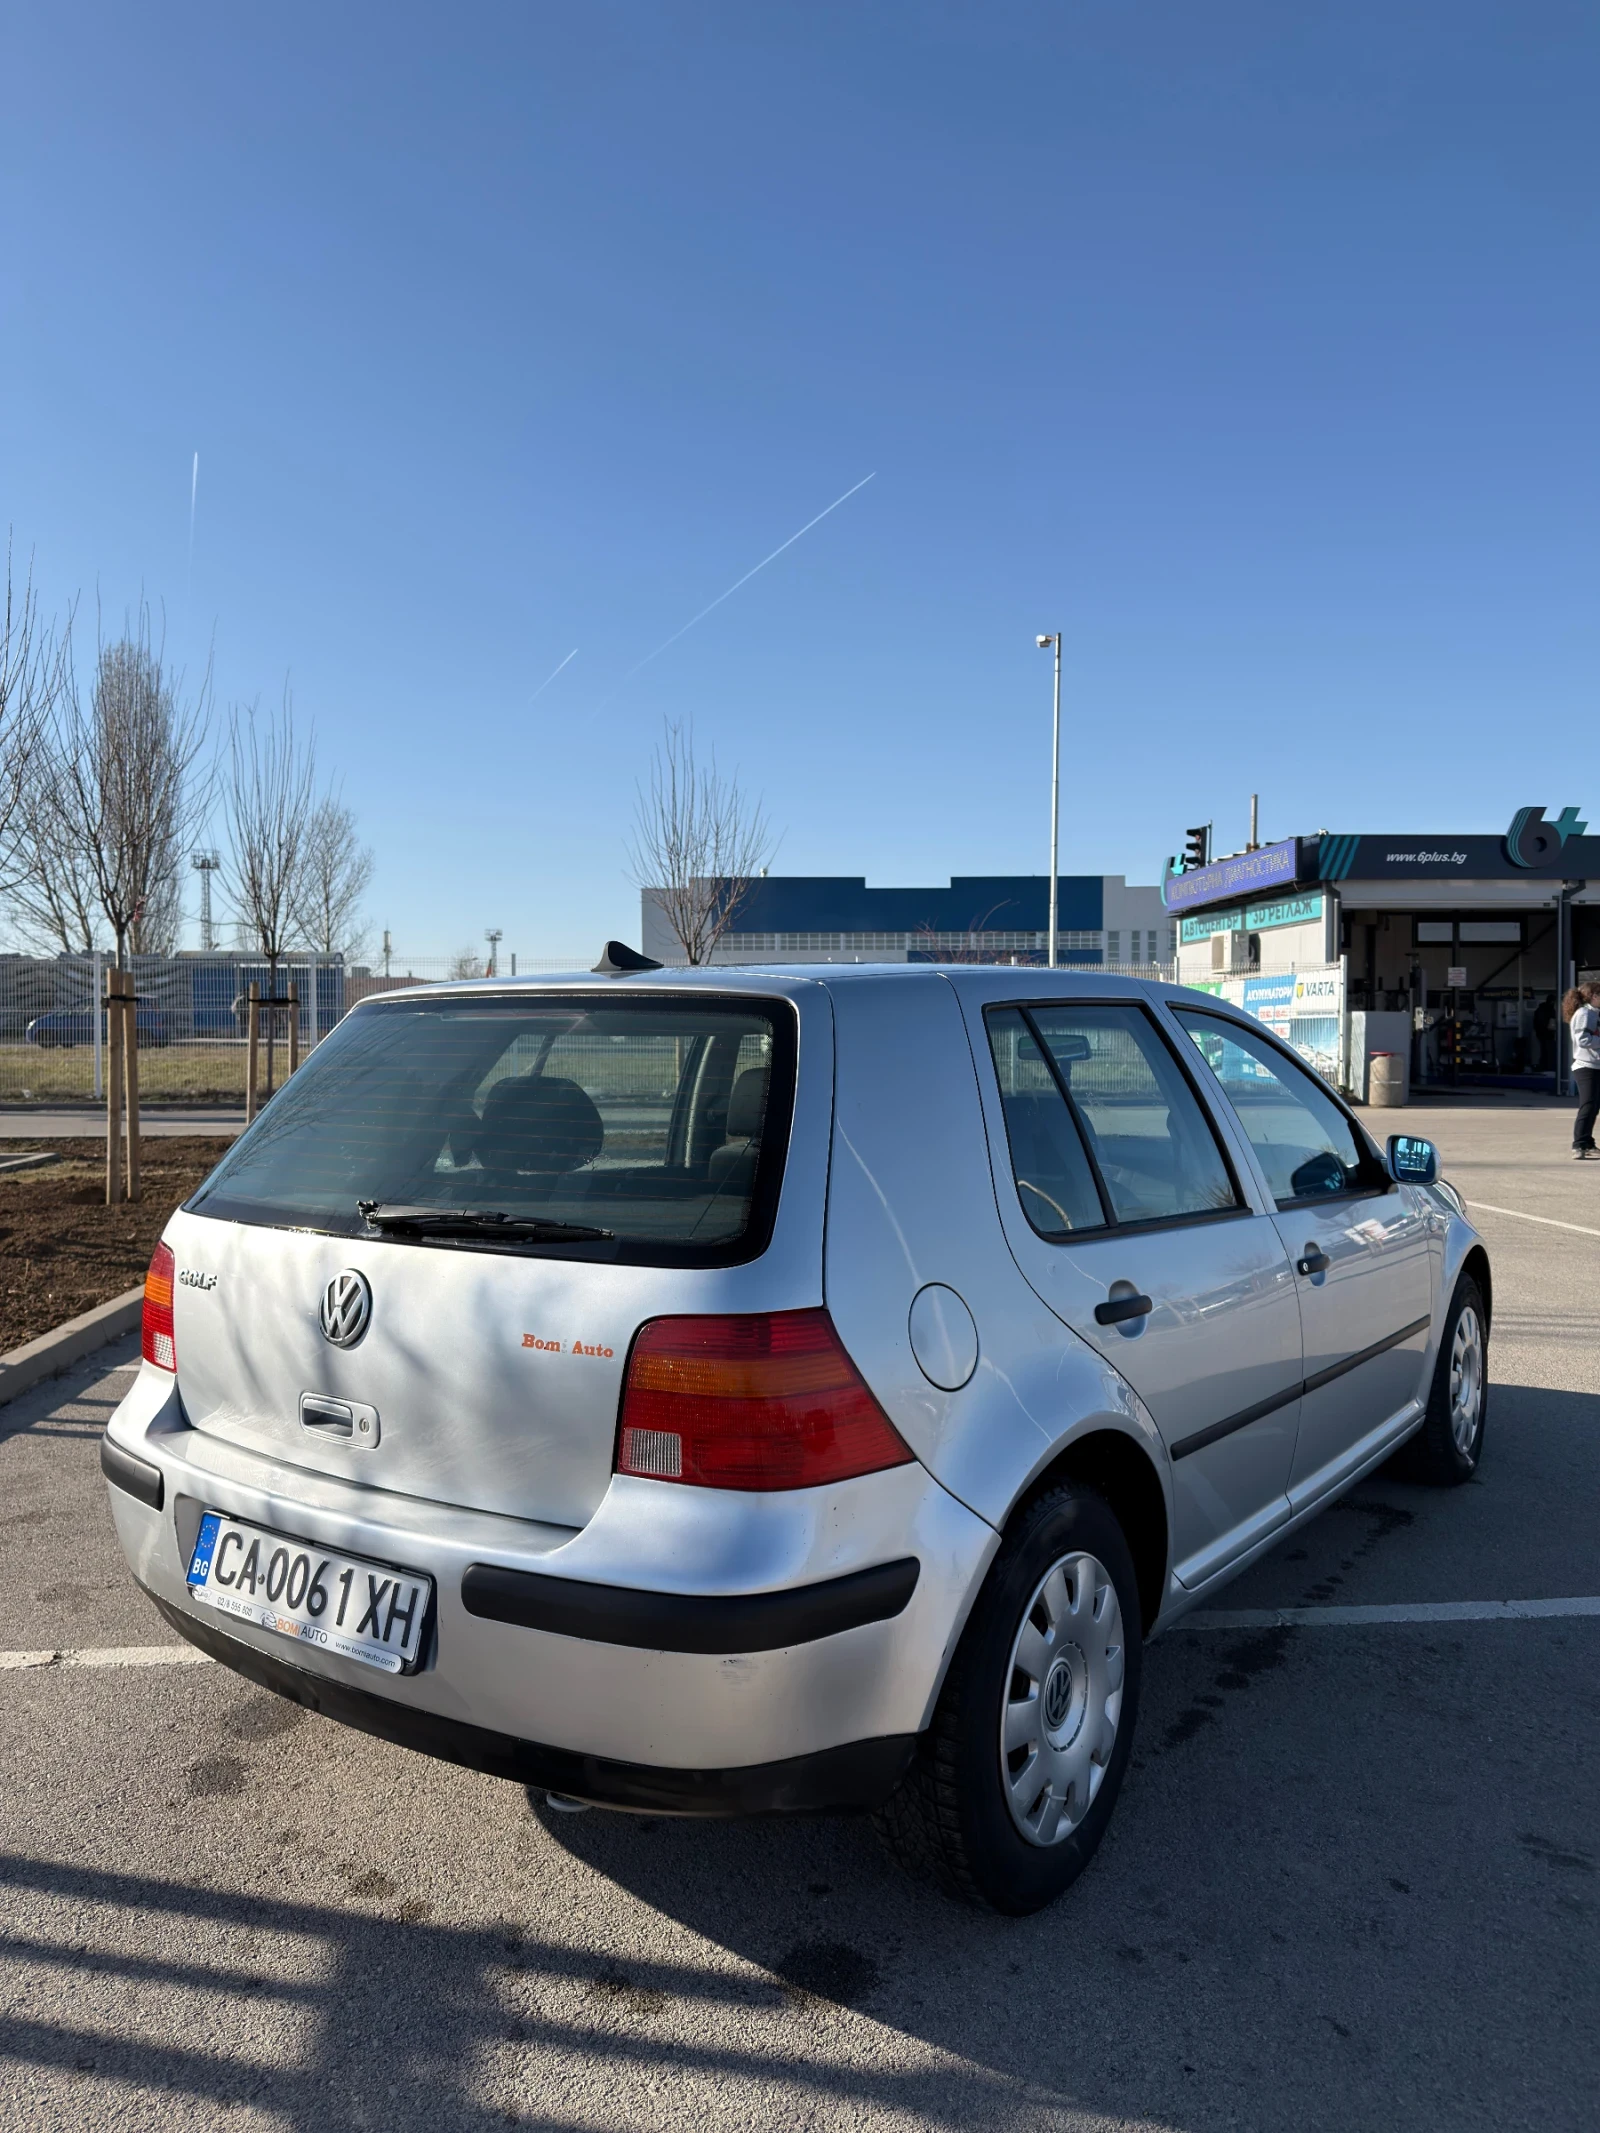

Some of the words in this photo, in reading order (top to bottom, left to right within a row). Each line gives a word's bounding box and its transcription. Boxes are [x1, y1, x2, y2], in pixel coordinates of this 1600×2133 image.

[1386, 851, 1467, 865] www.6plus.bg
[1306, 981, 1336, 996] VARTA
[179, 1269, 217, 1291] GOLF
[572, 1340, 614, 1358] Auto
[192, 1558, 210, 1577] BG
[277, 1618, 300, 1637] BOMI
[300, 1626, 328, 1644] AUTO
[335, 1641, 396, 1668] www.bomiauto.com
